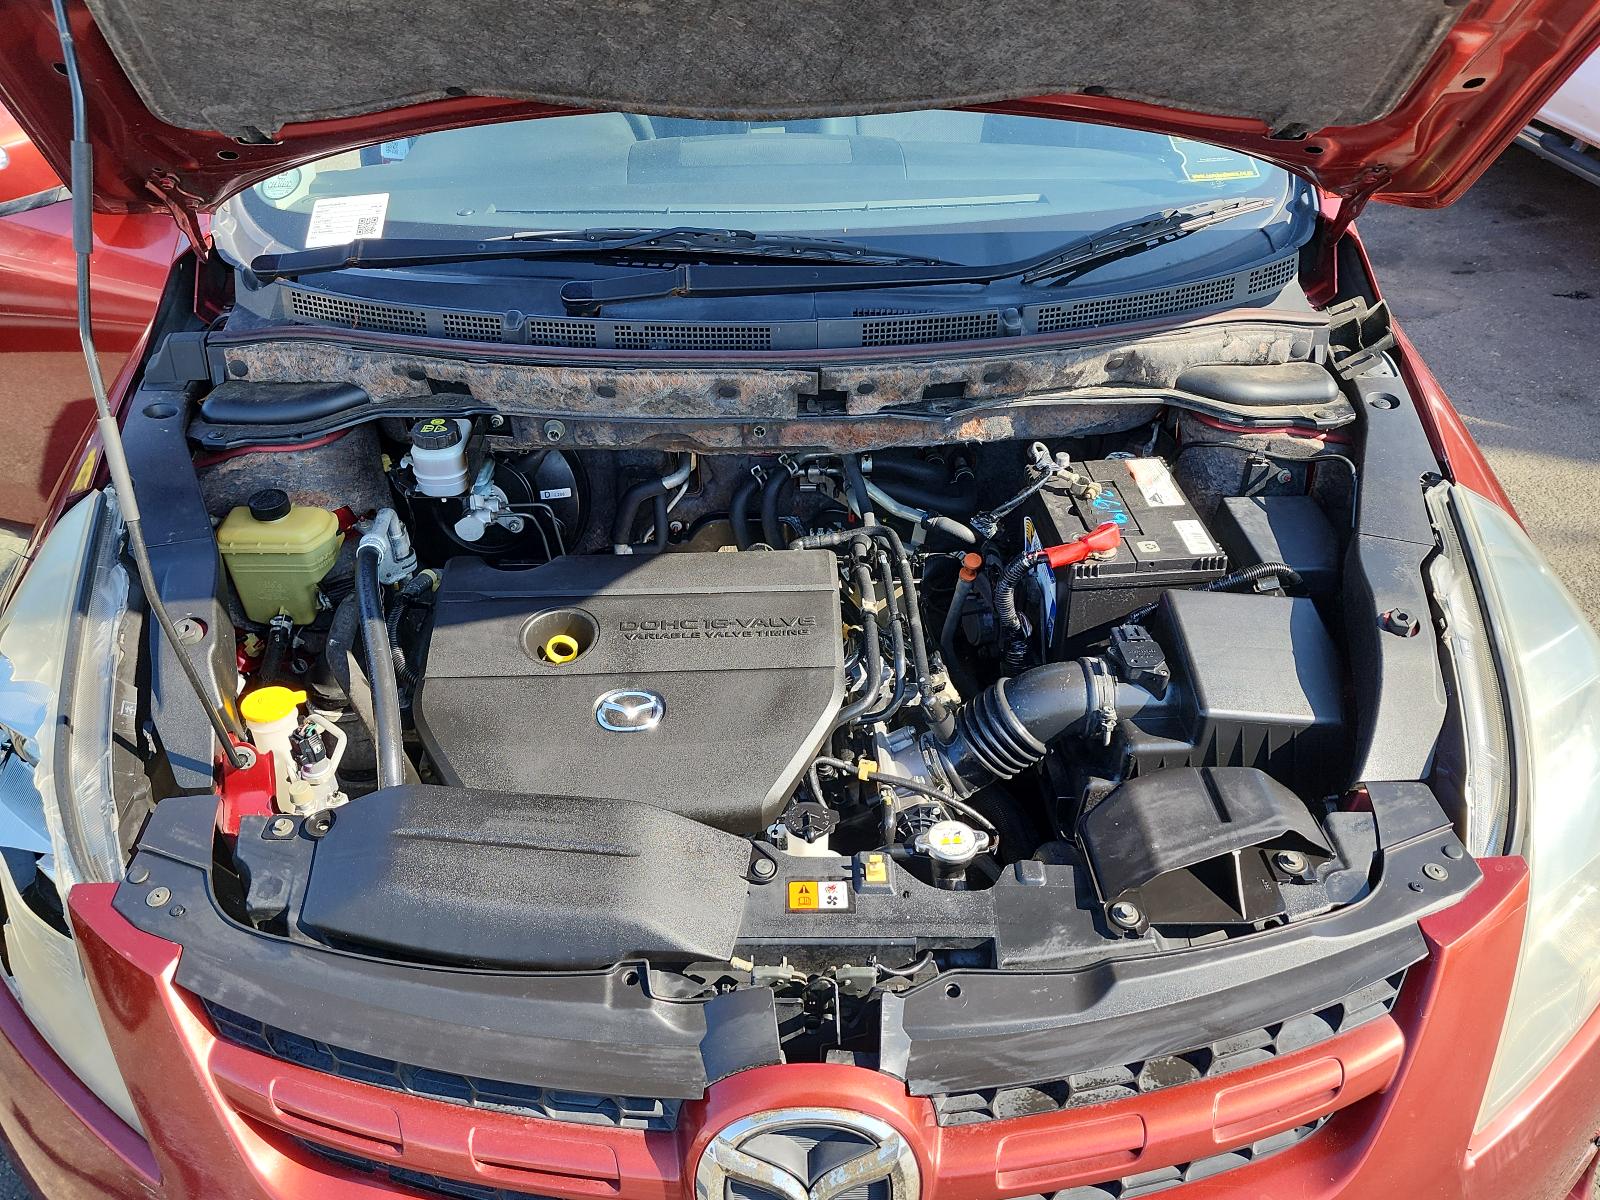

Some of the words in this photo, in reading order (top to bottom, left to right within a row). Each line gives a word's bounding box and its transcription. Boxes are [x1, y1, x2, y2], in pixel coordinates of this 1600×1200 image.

[619, 618, 698, 632] DOHC
[623, 631, 701, 641] VARIABLE
[704, 630, 752, 639] VALVE
[754, 629, 811, 638] TIMING
